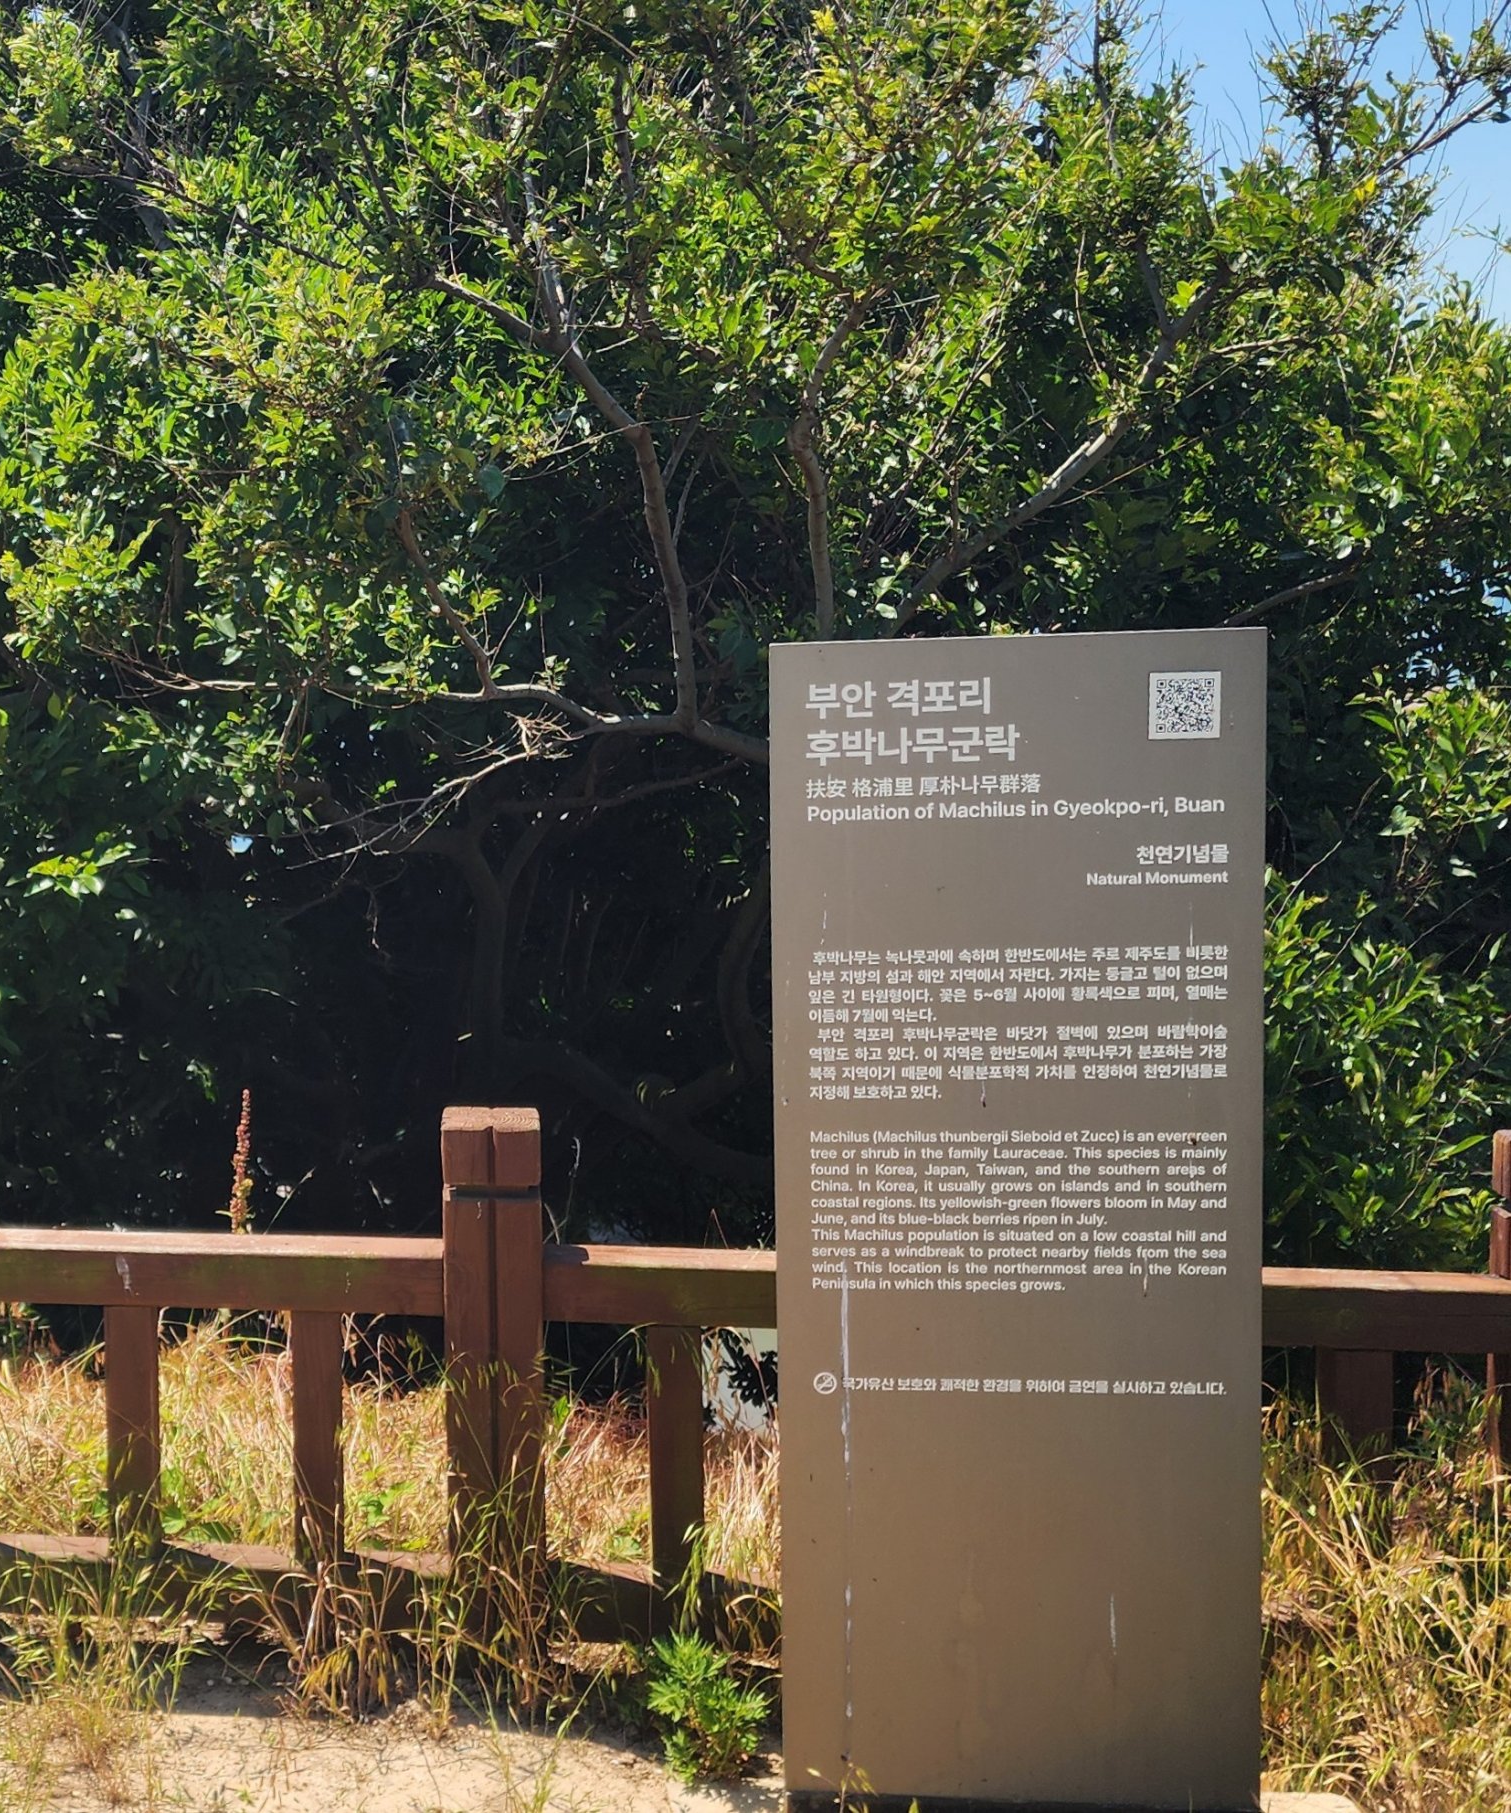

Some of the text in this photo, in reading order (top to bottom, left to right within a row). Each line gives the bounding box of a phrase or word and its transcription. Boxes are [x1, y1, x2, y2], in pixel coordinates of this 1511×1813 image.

[805, 676, 991, 719] 부안 격포리
[805, 723, 1020, 766] 후박나무군락
[805, 772, 1041, 799] 扶安 格浦里 厚朴나무群落
[807, 796, 1225, 825] Population of Machilus in Gyeokpo-ri, Buan
[1136, 843, 1229, 865] 천연기념물
[1086, 870, 1228, 886] Natural Monument
[812, 944, 1229, 966] 후박나무는 녹나뭇과에 속하며 한반도에서는 주로 제주도를 비롯한
[808, 969, 835, 985] 남부
[840, 969, 880, 985] 지방의
[885, 968, 913, 984] 섬과
[917, 968, 945, 983] 해안
[949, 967, 1004, 983] 지역에서
[1009, 966, 1055, 982] 자란다.
[1059, 966, 1101, 982] 가지는
[1105, 966, 1148, 981] 둥글고
[1185, 965, 1228, 980] 없으며
[808, 984, 1228, 1004] 잎은 긴 타원형이다. 꽃은 5~6월 사이에 피며, 열매는
[808, 1006, 937, 1023] 이듬해 7월에 익는다.
[817, 1024, 1149, 1043] 부안 격포리 후박나무군락은 바닷가 절벽에 있으며
[808, 1043, 1228, 1062] 역할도 하고 있다. 이 지역은 한반도에서 후박나무가 분포하는 가장
[841, 1063, 1228, 1081] 지역이기 때문에 가치를 인정하여 천연기념물로
[809, 1084, 942, 1100] 지정해 보호하고 있다.
[810, 1129, 1155, 1145] Machilus (Machilus thunbergii Siebold et Zucc) is an
[809, 1146, 1228, 1161] tree or shrub the family Lauraceae. This species mainly
[810, 1162, 1228, 1178] found in Korea, Japan, Taiwan, and the southern of
[810, 1179, 1227, 1194] China. In Korea, usually grows on islands and in southern
[810, 1195, 1227, 1211] coastal regions. Its yellowish-green flowers bloom in May and
[810, 1212, 1108, 1228] June, and its blue-black berries ripen July.
[810, 1228, 1227, 1243] This Machilus population situated on low coastal hill and
[811, 1245, 1227, 1261] serves as windbreak to protect nearby fields the sea
[853, 1261, 1227, 1275] This location the northernmost area Korean
[893, 1277, 1065, 1293] which this species grows.
[897, 1377, 1227, 1395] 보호와 위하여 실시하고 있습니다.
